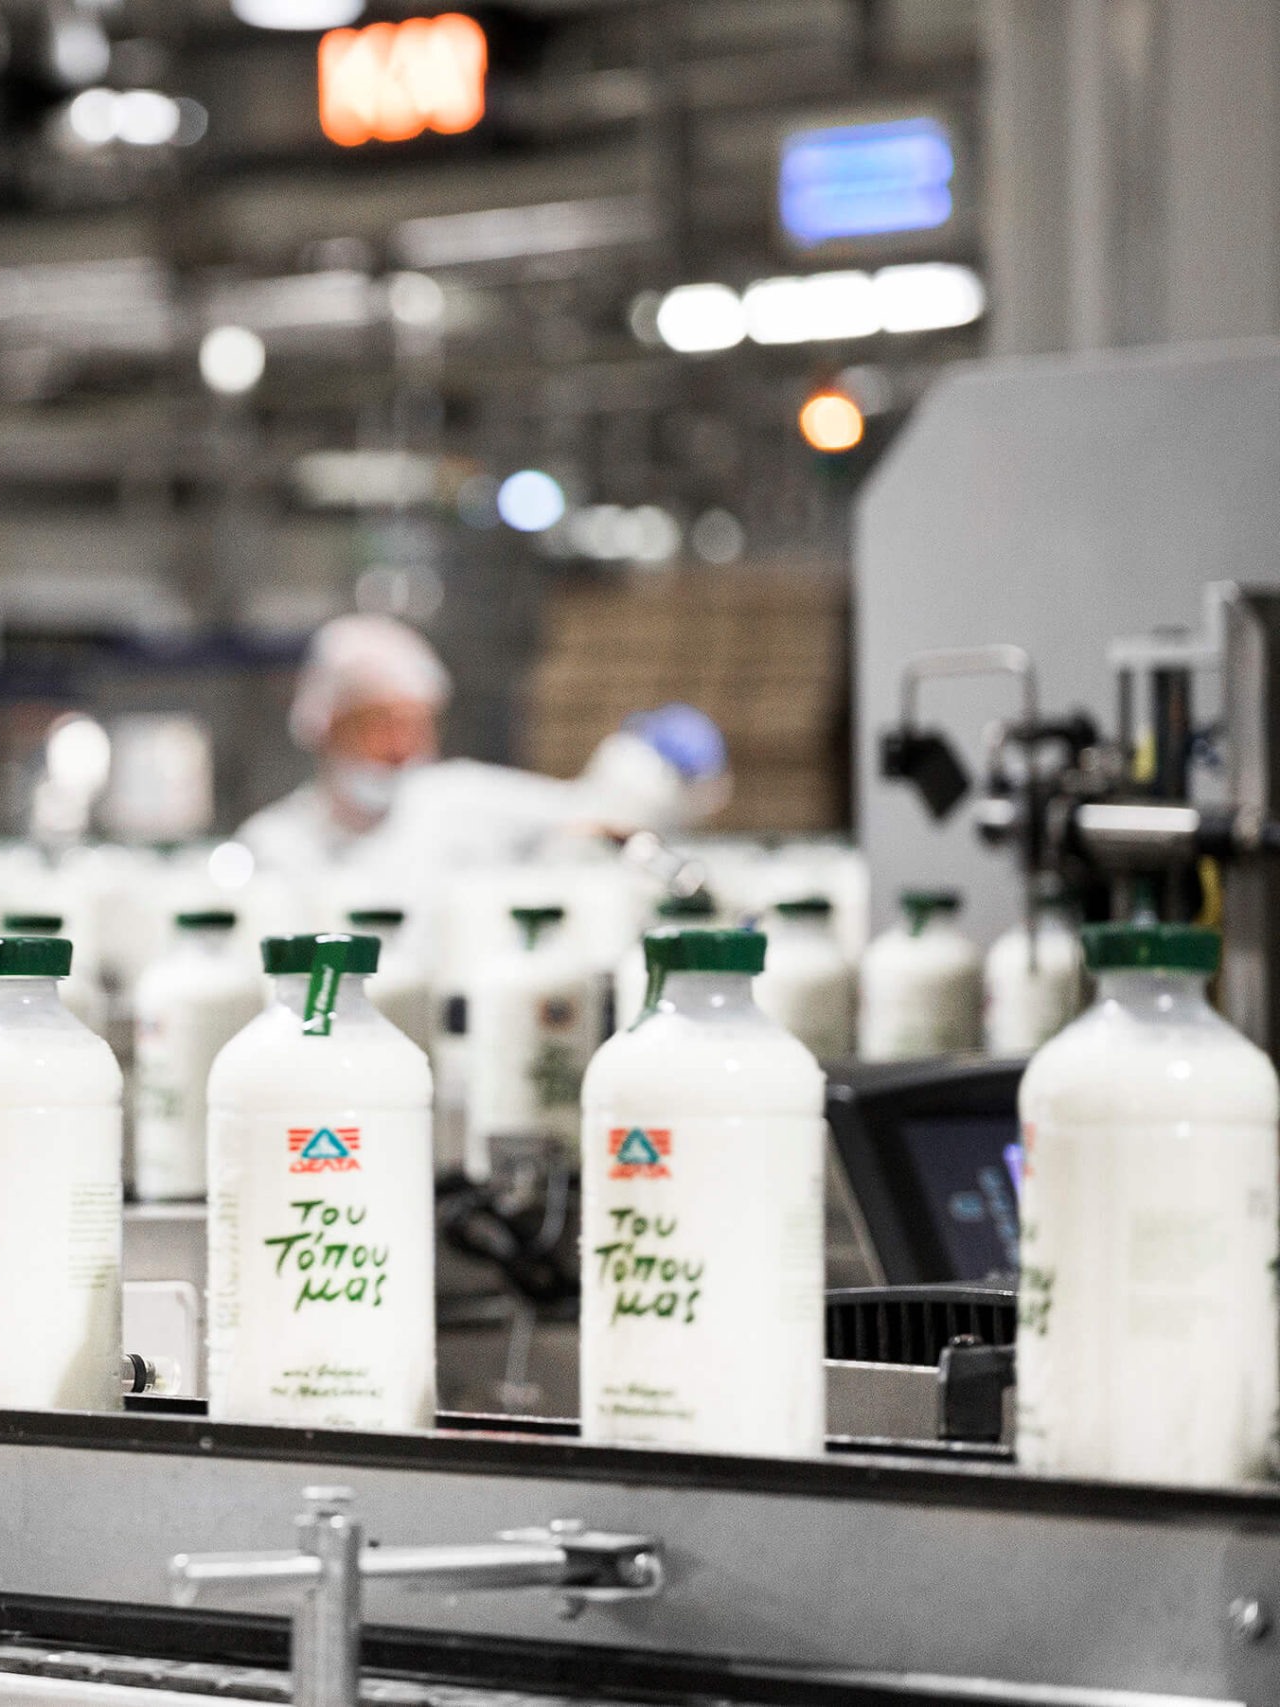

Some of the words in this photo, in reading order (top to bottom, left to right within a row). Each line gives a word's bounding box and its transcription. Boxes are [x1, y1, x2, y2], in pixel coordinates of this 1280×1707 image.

[290, 1200, 365, 1226] Του
[264, 1231, 387, 1280] Τόπου
[295, 1274, 386, 1311] μας
